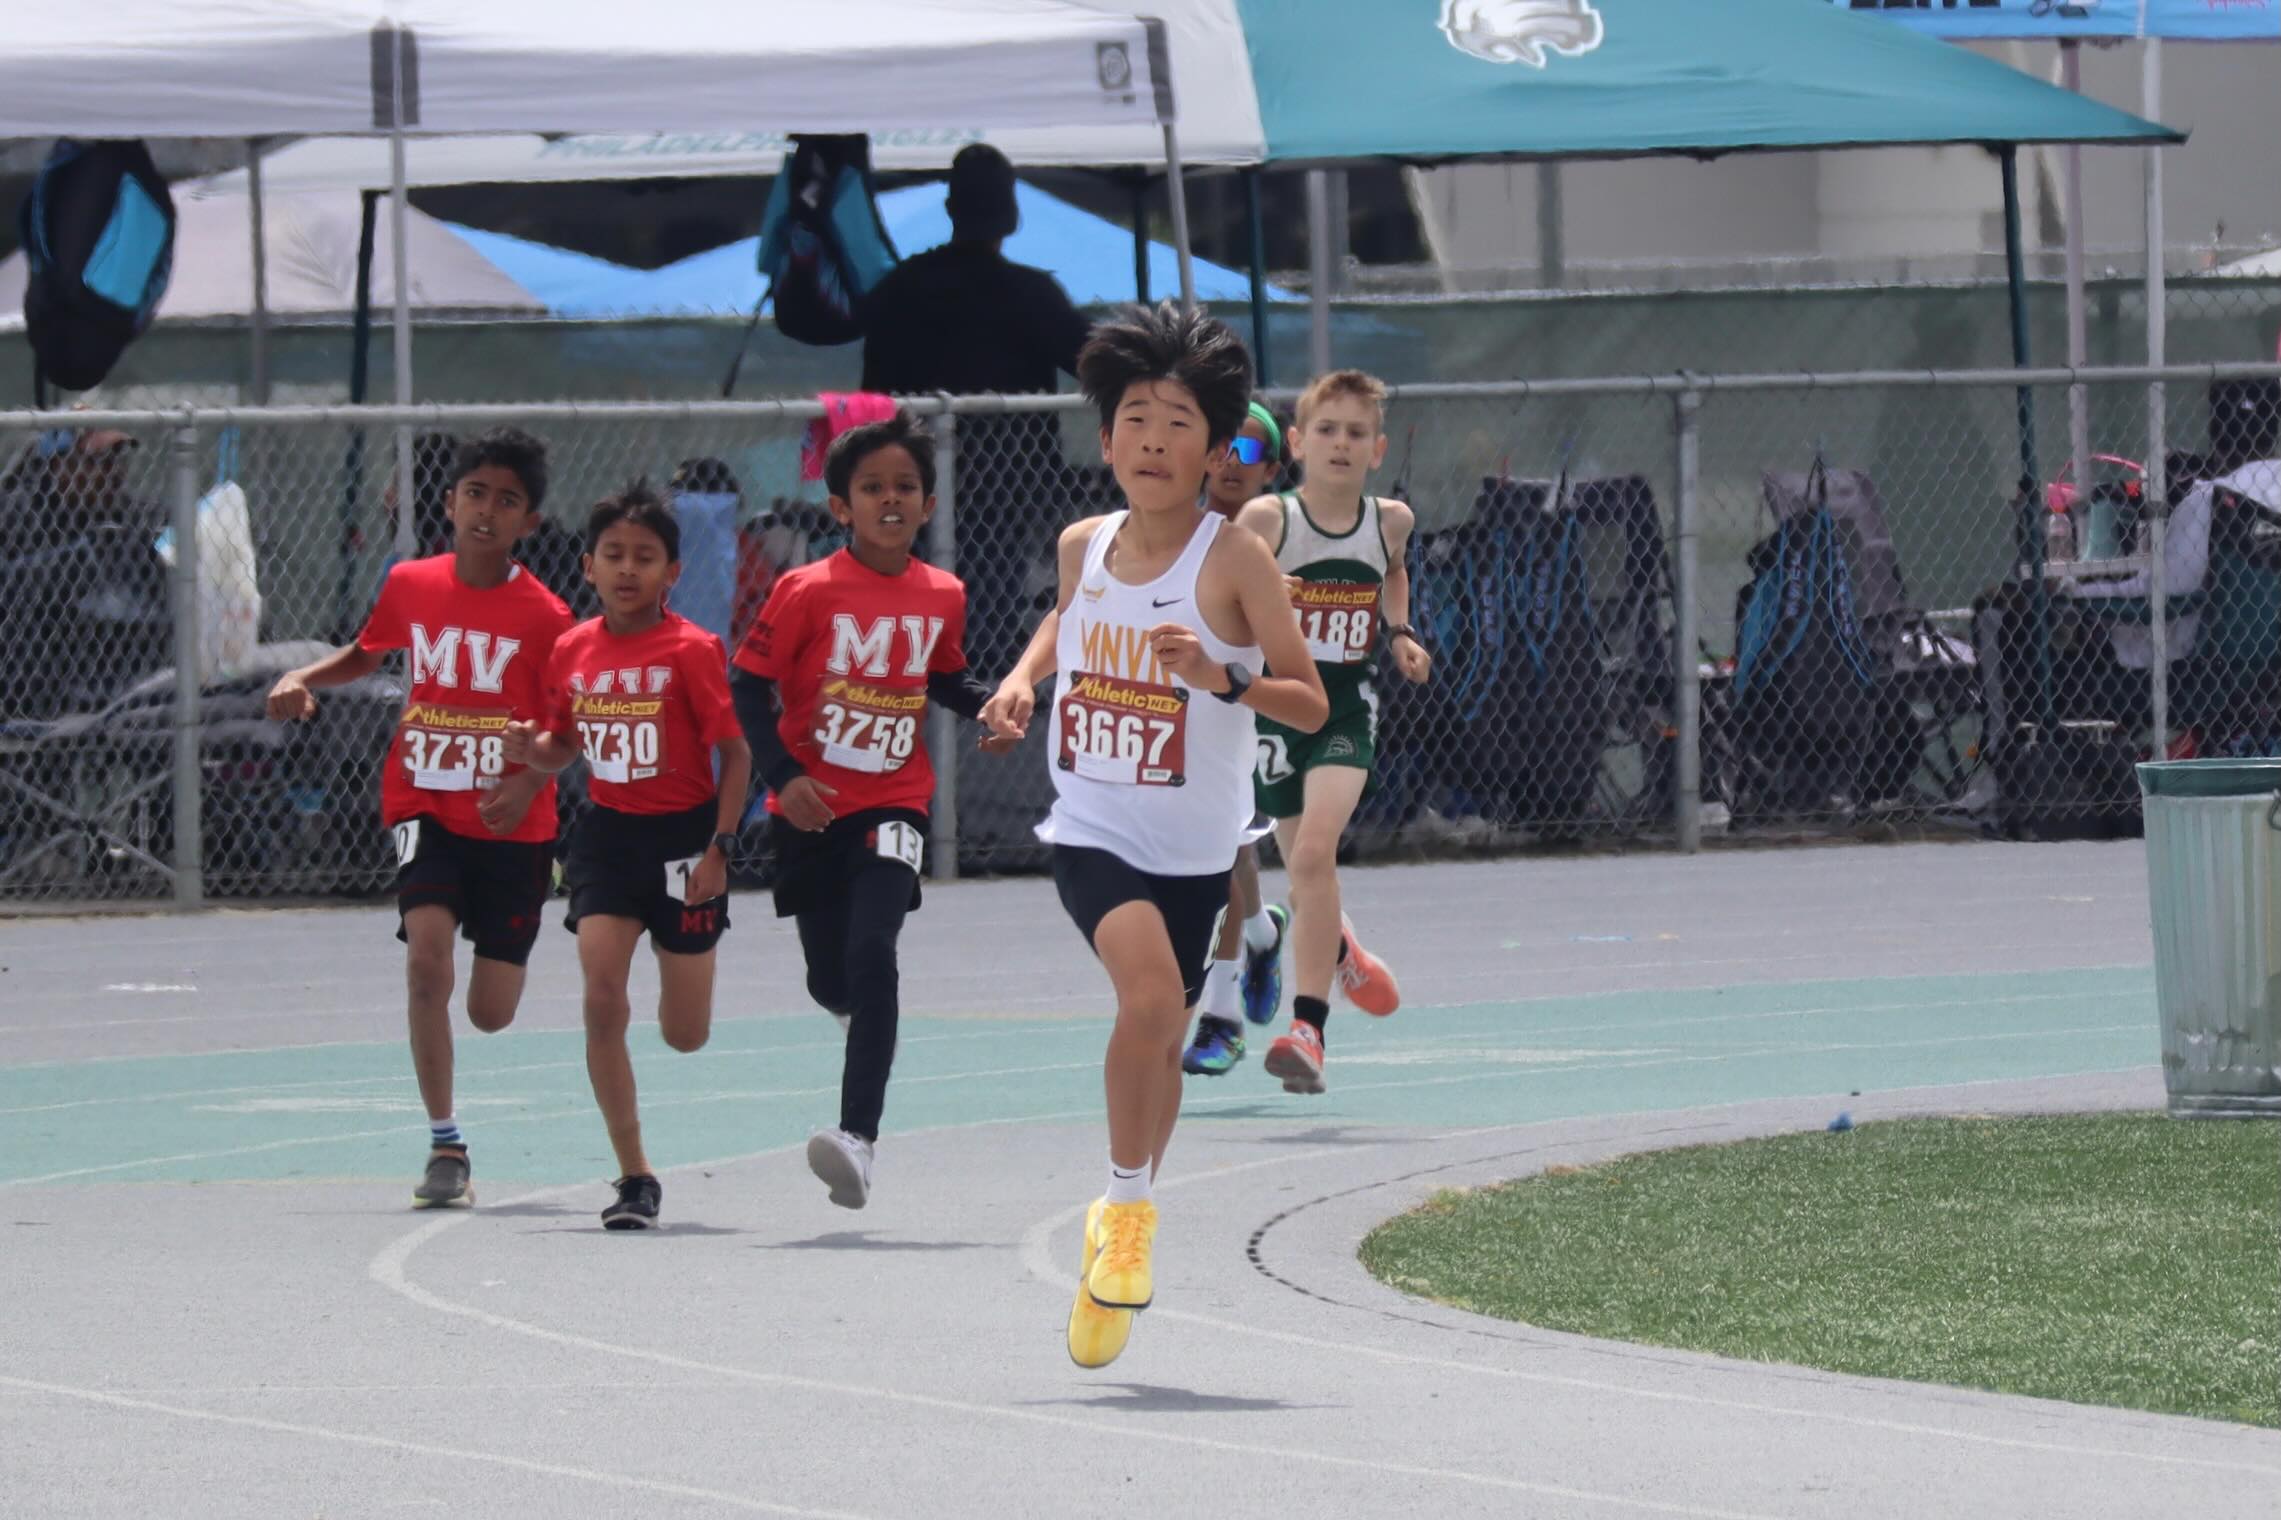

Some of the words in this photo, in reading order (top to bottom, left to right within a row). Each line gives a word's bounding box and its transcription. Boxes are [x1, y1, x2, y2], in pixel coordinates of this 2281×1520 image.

[826, 613, 945, 677] MV
[1295, 608, 1371, 649] 188
[410, 622, 521, 694] MV
[403, 729, 505, 776] 3738
[577, 721, 659, 766] 3730
[815, 703, 917, 758] 3758
[1066, 703, 1175, 766] 3667
[889, 822, 918, 866] 13
